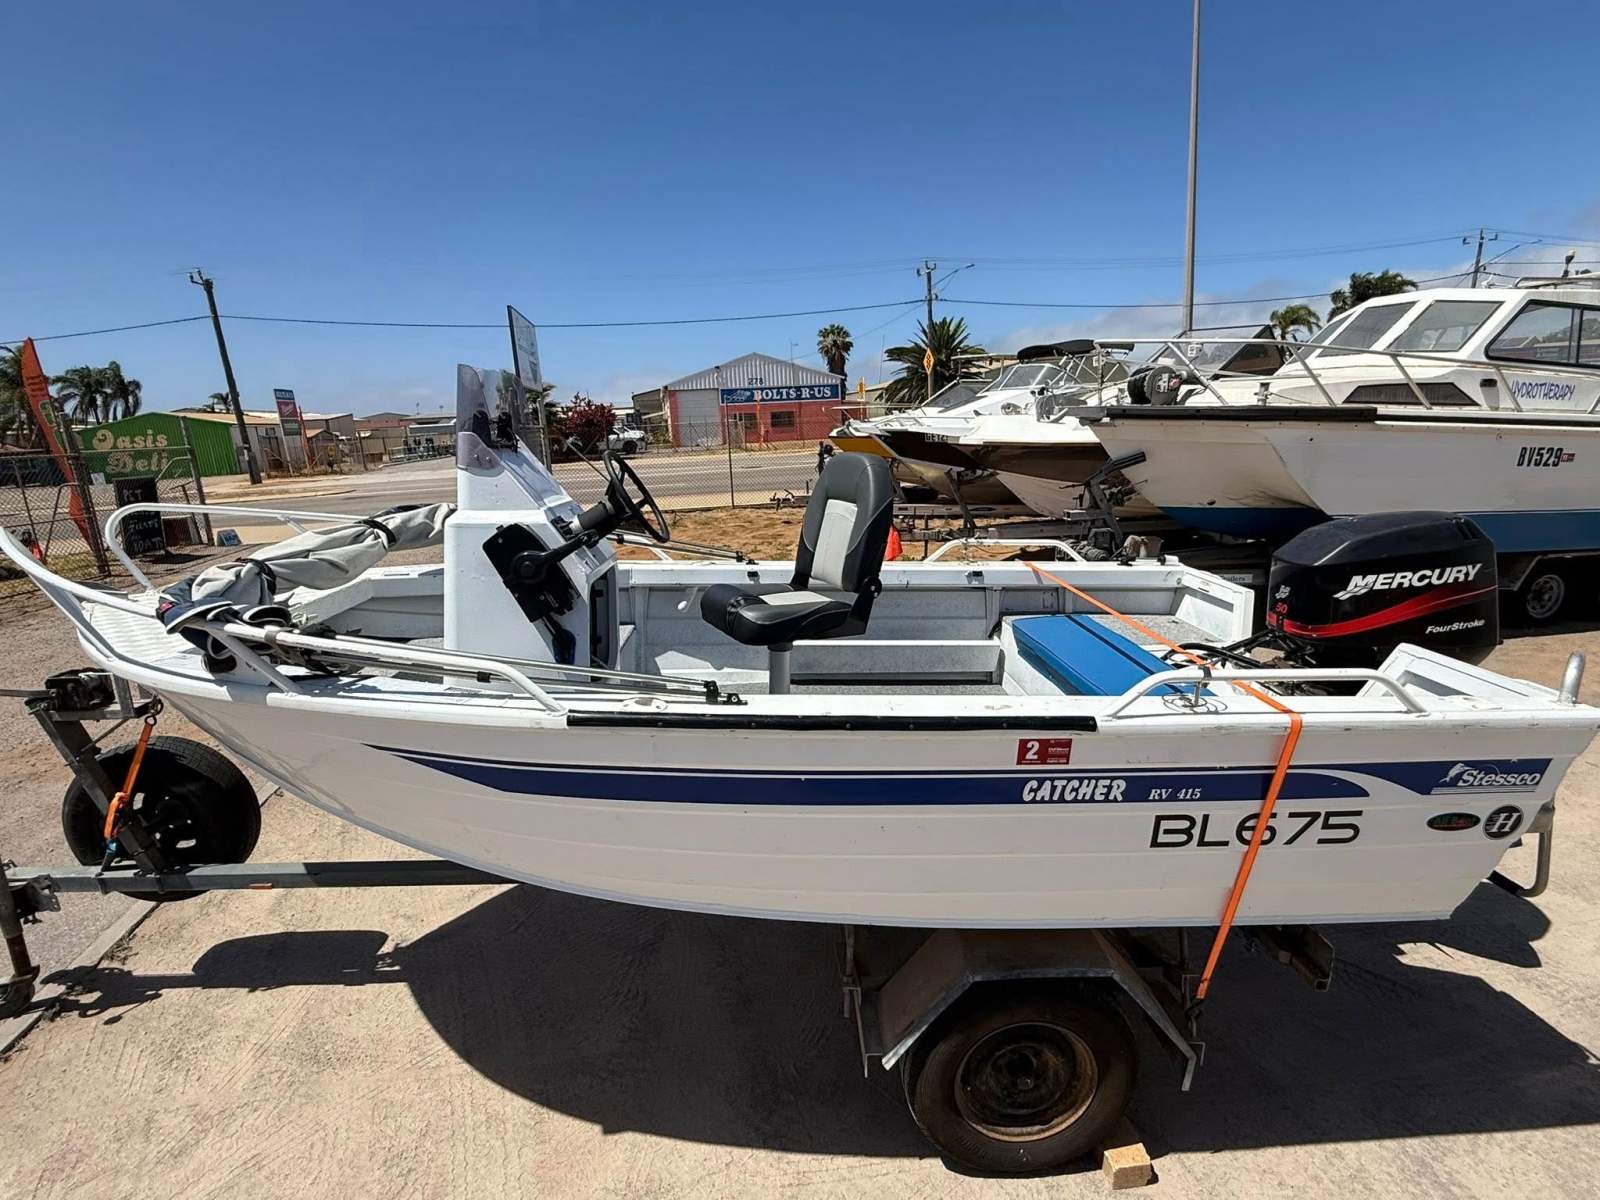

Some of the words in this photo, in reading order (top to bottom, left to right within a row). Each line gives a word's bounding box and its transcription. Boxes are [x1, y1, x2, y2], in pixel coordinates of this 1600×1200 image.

[753, 386, 832, 401] BOLTS-R-US
[92, 429, 168, 451] Oasis
[1517, 446, 1564, 467] BV529
[1334, 563, 1482, 600] MERCURY
[1425, 618, 1486, 634] FourStroke
[1024, 740, 1040, 760] 2
[1457, 769, 1541, 786] Stessco
[1022, 778, 1127, 802] CATCHER
[1148, 788, 1172, 801] RV
[1176, 788, 1202, 801] 415
[1150, 810, 1363, 848] BL675
